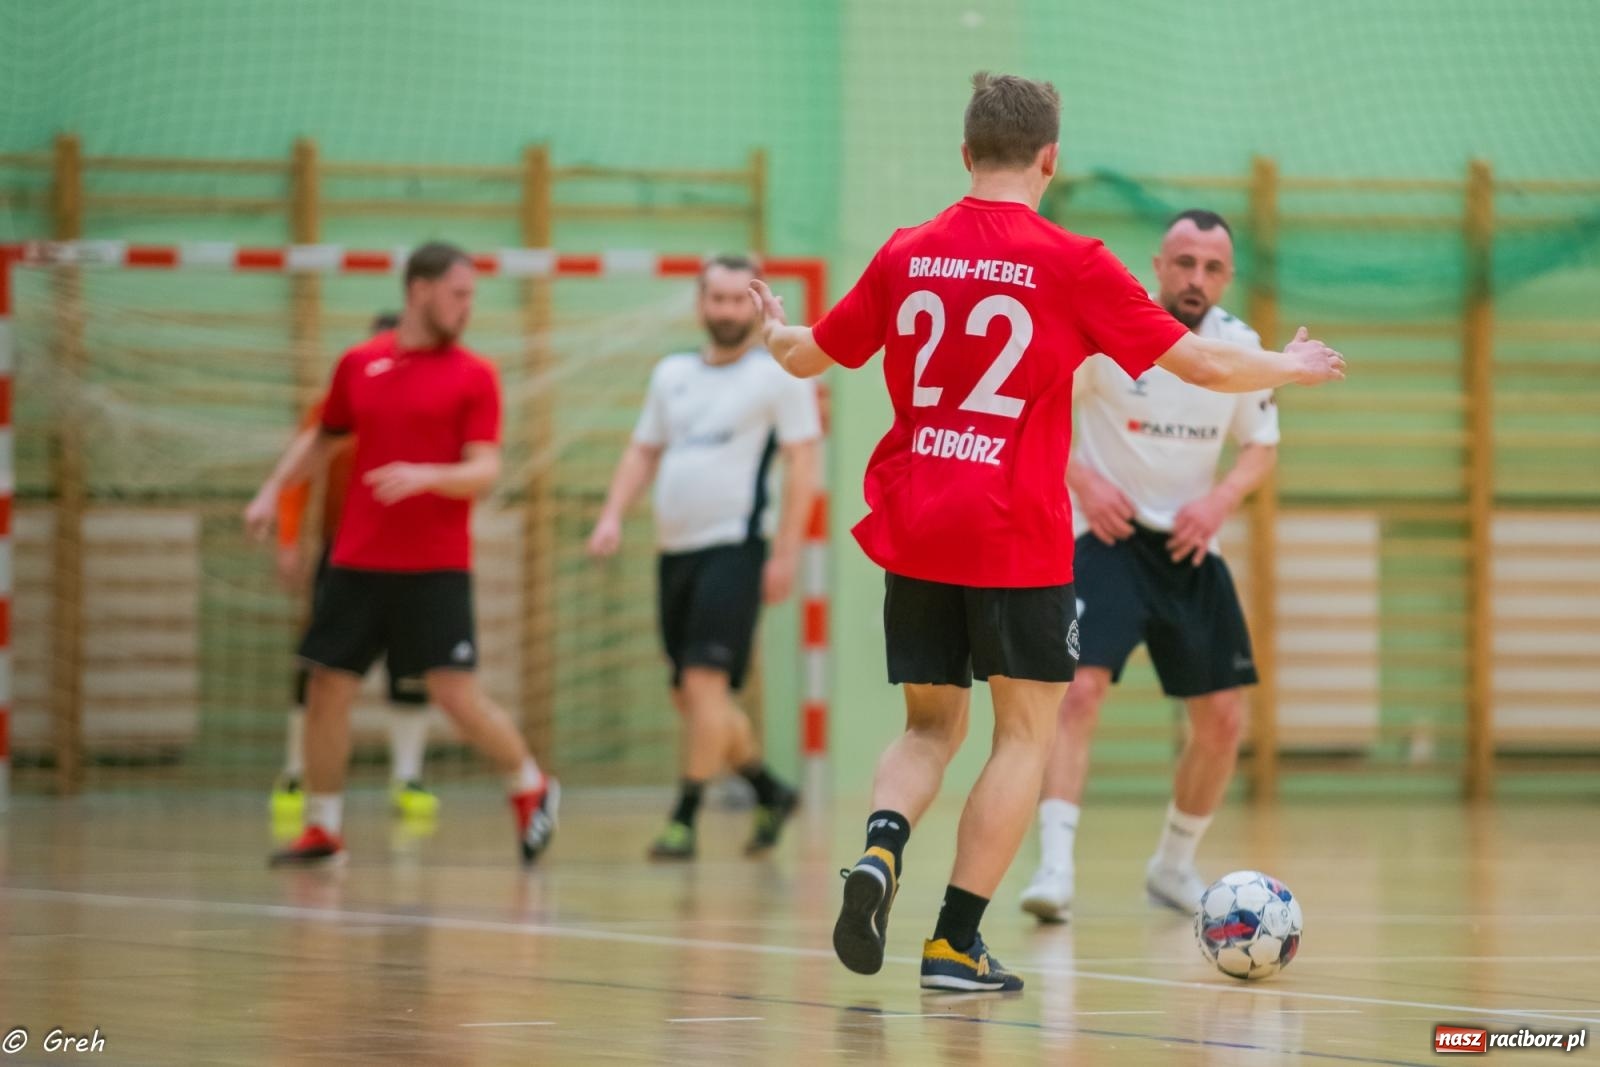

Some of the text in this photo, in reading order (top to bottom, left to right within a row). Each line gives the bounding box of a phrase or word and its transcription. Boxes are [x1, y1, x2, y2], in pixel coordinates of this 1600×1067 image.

[908, 256, 1036, 288] BRAUN-MEBEL
[896, 290, 1033, 419] 22
[1141, 420, 1218, 439] PARTNER
